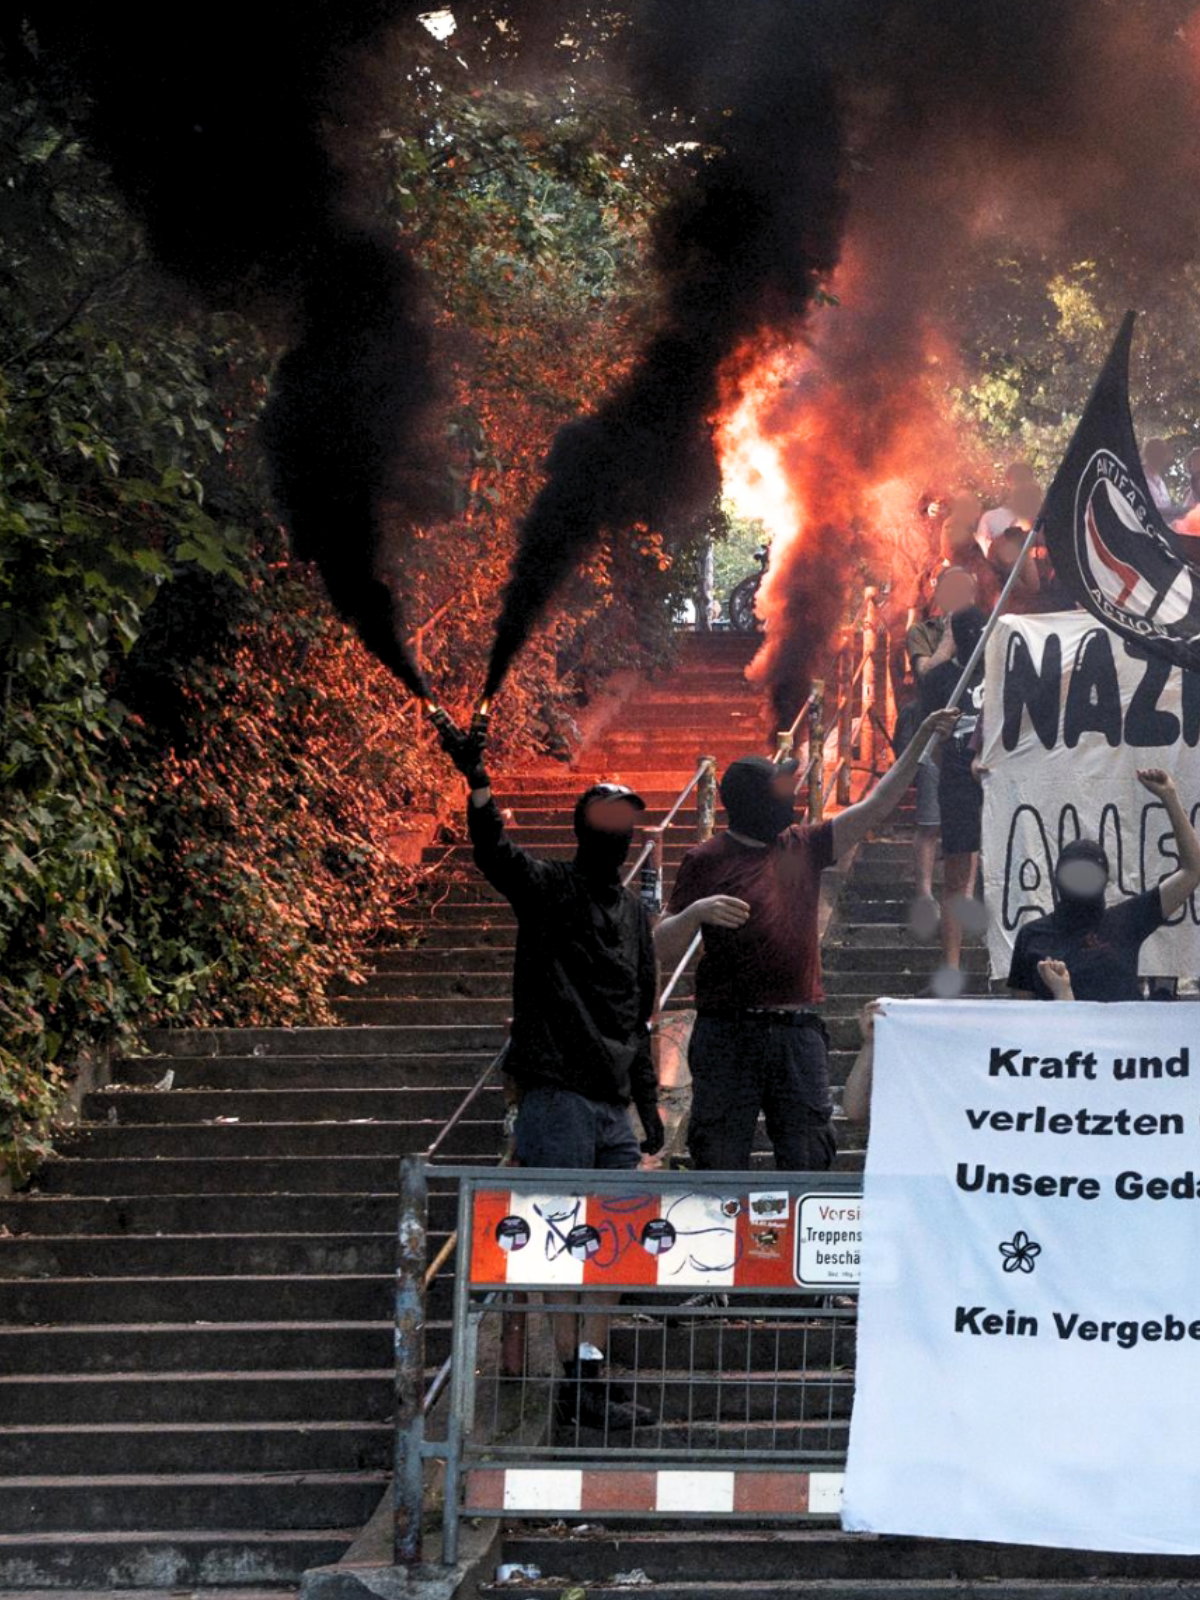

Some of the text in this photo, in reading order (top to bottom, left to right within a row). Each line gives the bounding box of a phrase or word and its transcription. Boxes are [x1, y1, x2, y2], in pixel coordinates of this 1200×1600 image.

[1092, 588, 1168, 636] ACTION
[988, 1047, 1098, 1080] Kraft
[1112, 1047, 1190, 1081] und
[965, 1106, 1184, 1136] verletzten
[956, 1163, 1101, 1200] Unsere
[955, 1306, 1038, 1337] Kein
